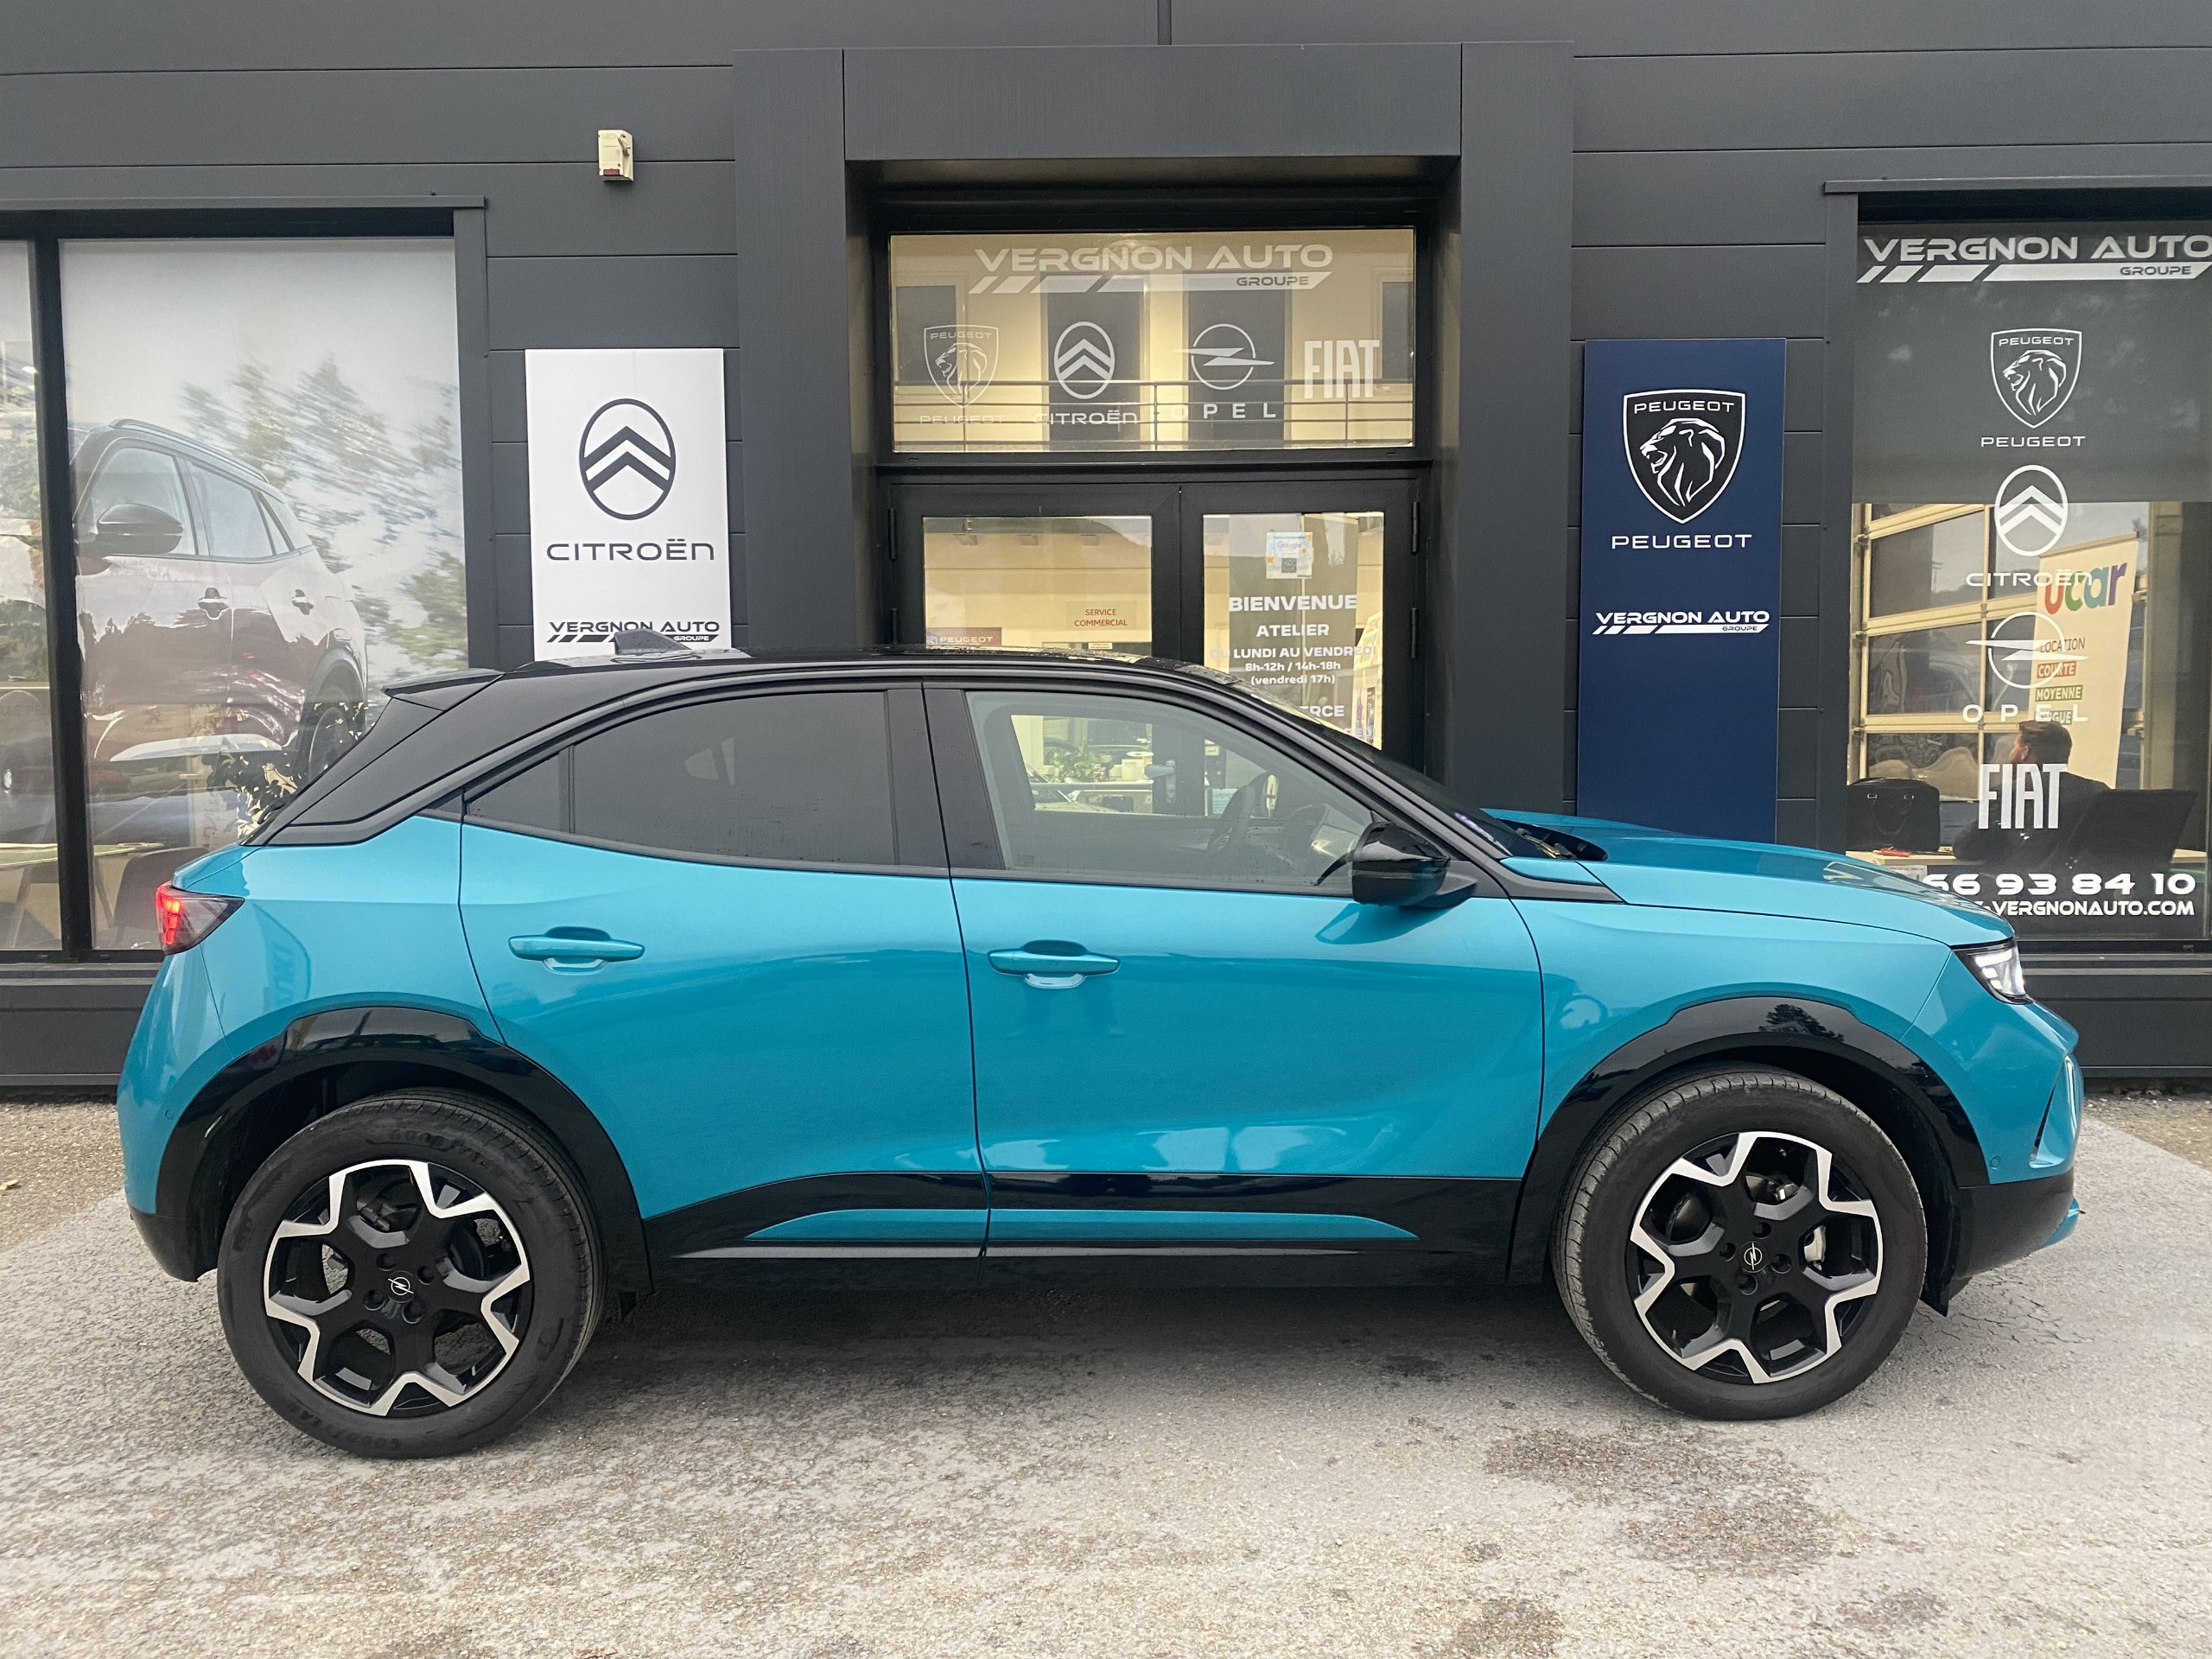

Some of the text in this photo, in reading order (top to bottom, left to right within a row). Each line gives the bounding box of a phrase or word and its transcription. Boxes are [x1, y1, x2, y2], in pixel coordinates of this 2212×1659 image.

[1864, 235, 2212, 262] VERGNON AUTO
[974, 244, 1333, 272] VERGNON AUTO
[2120, 265, 2192, 276] GROUPE
[1236, 276, 1310, 287] GROUPE
[930, 332, 992, 340] PEUGEOT
[1999, 336, 2075, 347] PEUGEOT
[1304, 340, 1381, 399] FIAT
[1170, 402, 1277, 420] OPEL
[1633, 400, 1735, 415] PEUGEOT
[919, 414, 1005, 424] PEUGEOT
[1980, 435, 2087, 448] PEUGEOT
[1611, 534, 1752, 550] PEUGEOT
[1229, 594, 1357, 612] BIENVENUE
[1595, 610, 1770, 625] VERGNON AUTO
[549, 621, 720, 632] VERGNON AUTO
[1256, 624, 1330, 638] ATELIER
[1233, 648, 1276, 658] LUNDI
[1279, 648, 1300, 658] AU
[1245, 662, 1285, 671] 8h-12h
[1295, 661, 1341, 671] 14h-18h
[1250, 674, 1336, 686] (vendredi 17h)
[2036, 686, 2082, 702] MOYENNE
[1962, 704, 2088, 722] OPEL
[1978, 763, 2069, 830] FIAT
[1995, 873, 2057, 895] 93
[2071, 873, 2136, 895] 84
[2151, 873, 2196, 895] 10
[1974, 900, 2195, 916] VERGNONAUTO.COM
